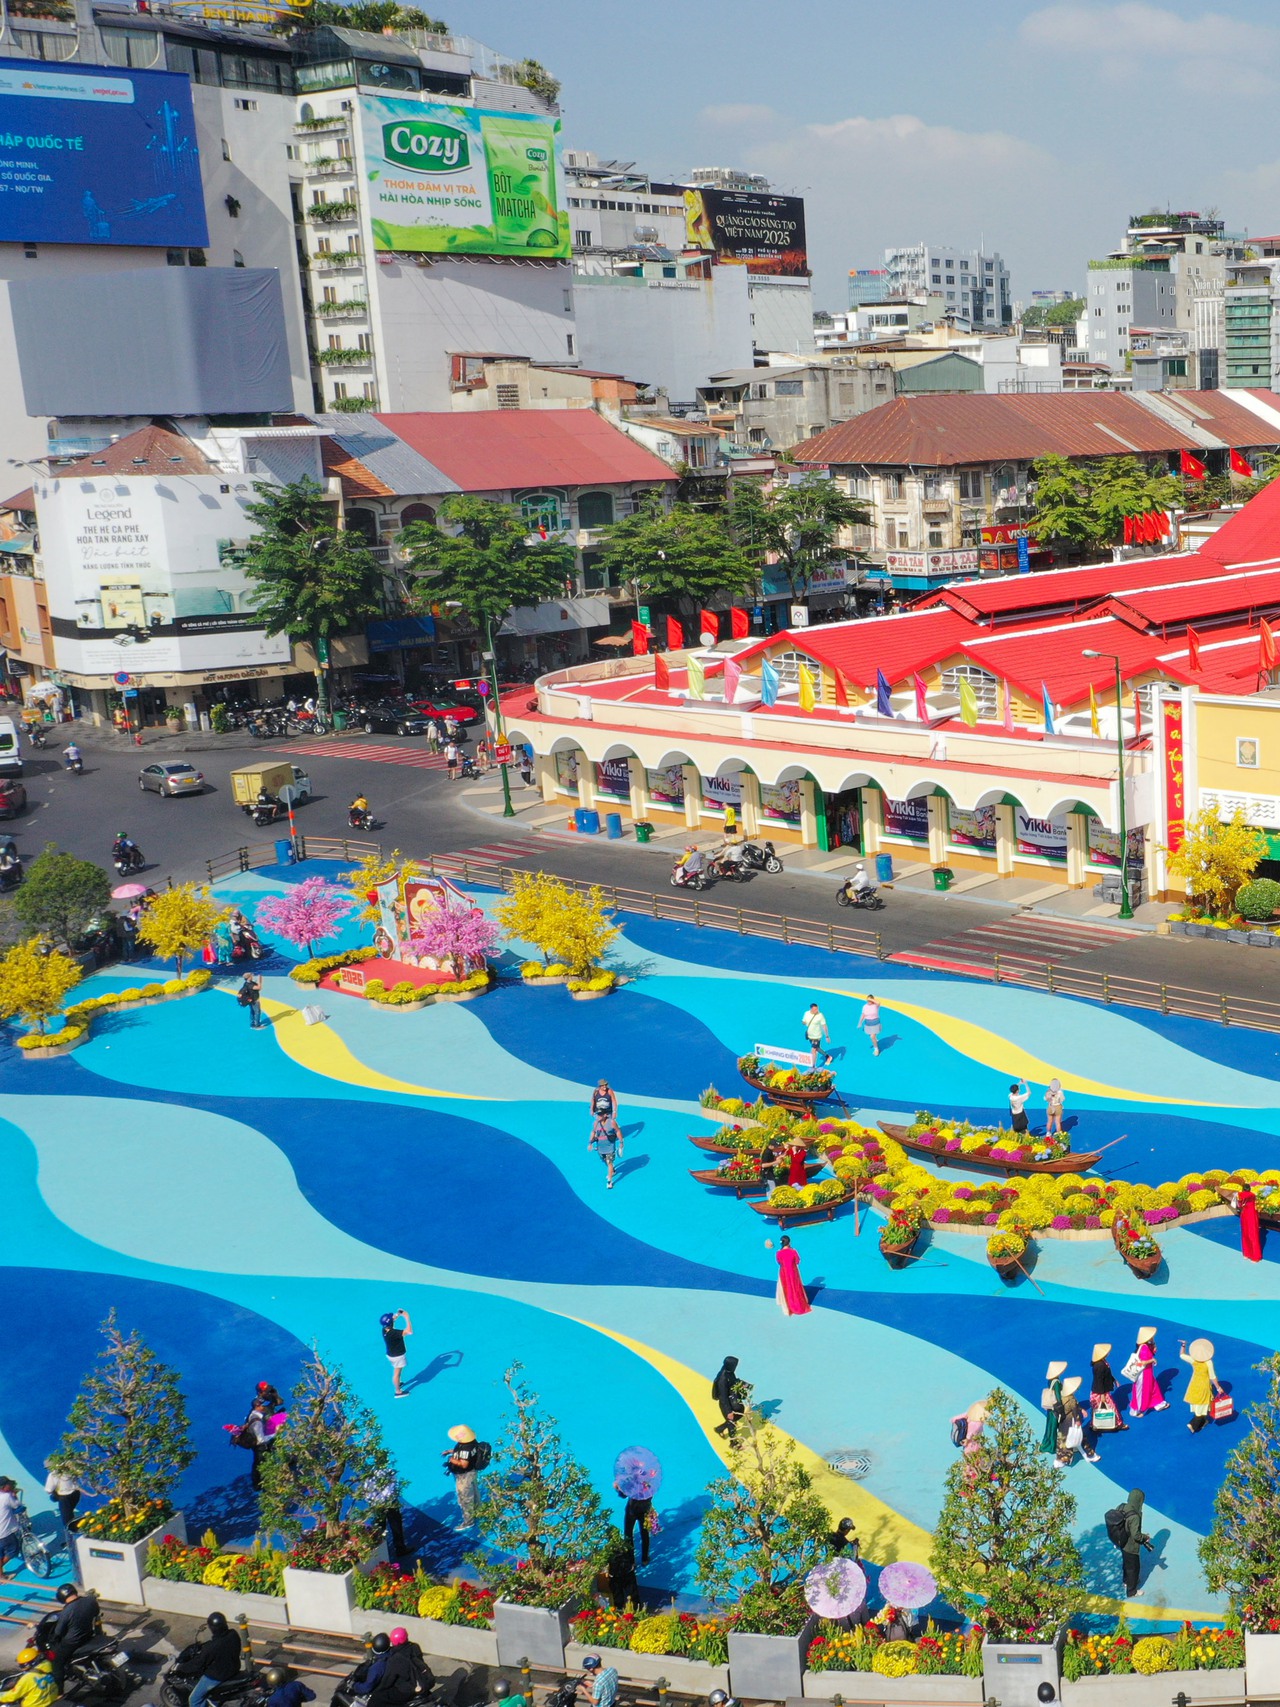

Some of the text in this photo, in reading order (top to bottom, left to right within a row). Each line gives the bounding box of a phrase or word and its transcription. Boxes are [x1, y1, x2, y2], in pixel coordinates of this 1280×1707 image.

[26, 133, 63, 150] QUỐC
[66, 136, 84, 151] TẾ
[391, 127, 461, 164] Cozy
[527, 150, 545, 161] Cozy
[14, 172, 36, 181] QUỐC
[494, 172, 512, 197] BỘT
[15, 186, 43, 194] NQ/TW
[383, 179, 476, 195] THƠM ĐẬM VỊ TRÀ
[379, 190, 482, 208] HÀI HÒA NHỊP SỐNG
[496, 197, 536, 219] MATCHA
[744, 216, 760, 228] CÁO
[783, 220, 796, 231] TẠO
[725, 226, 790, 245] VIỆT NAM 2025
[87, 507, 132, 521] Legend
[598, 760, 622, 776] Vikki
[705, 776, 730, 791] Vikki
[886, 798, 916, 816] Vikki
[1019, 815, 1052, 834] Vikki
[342, 970, 364, 986] 2026
